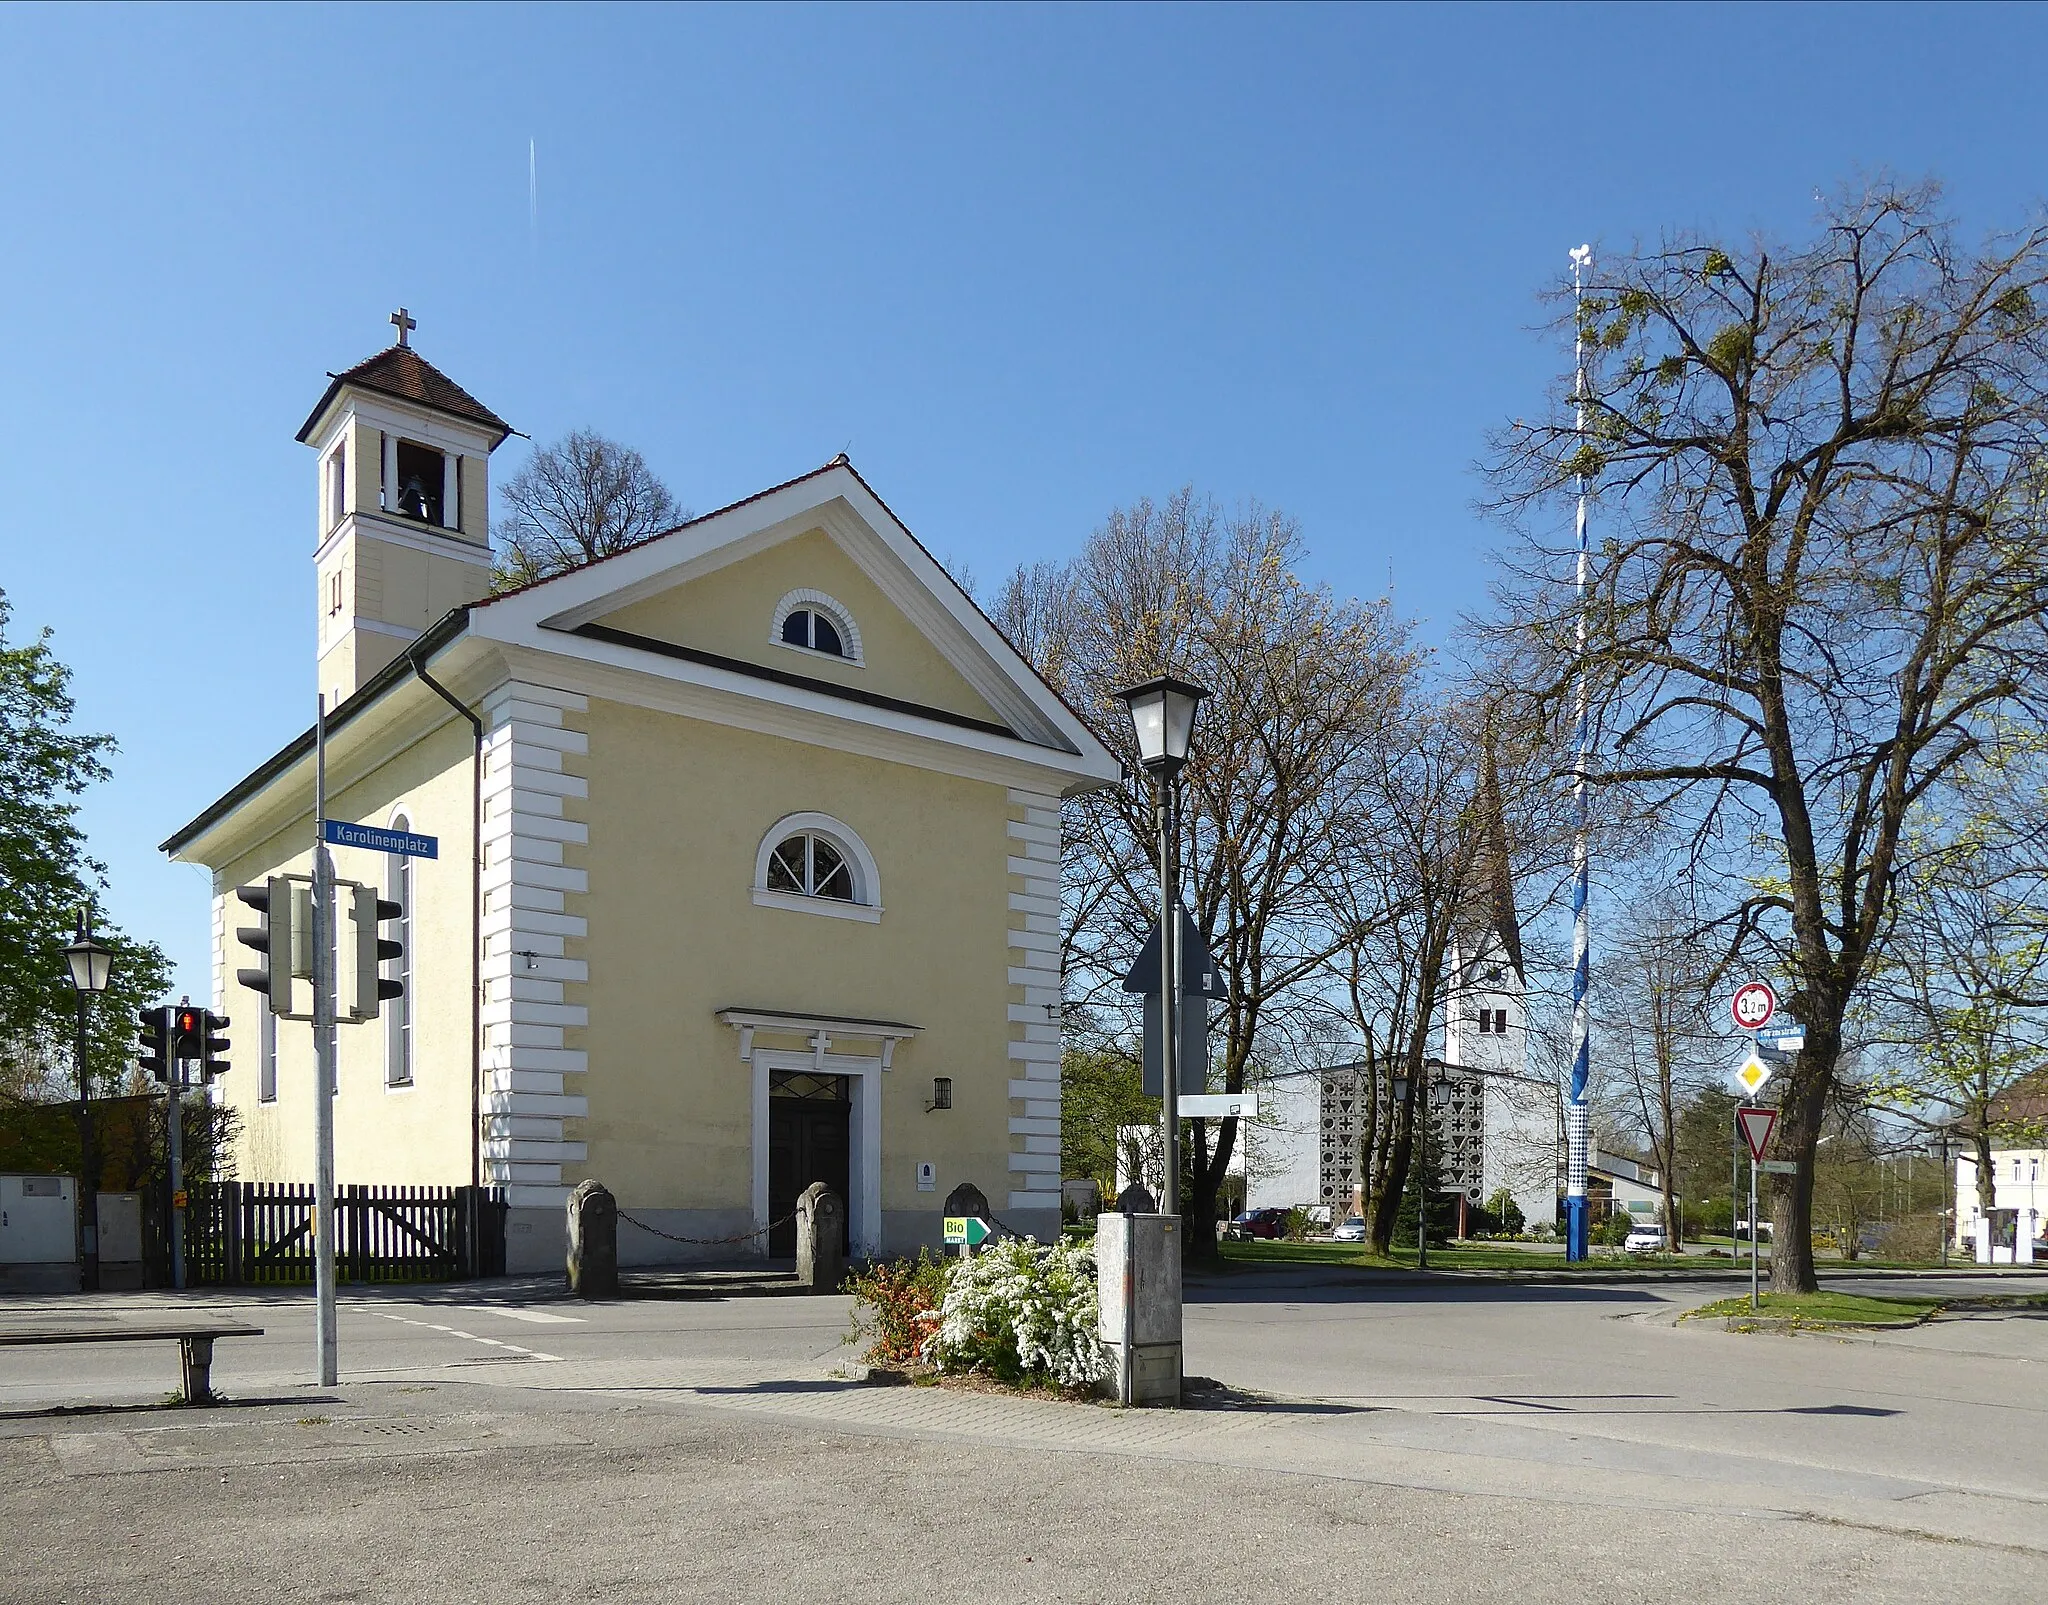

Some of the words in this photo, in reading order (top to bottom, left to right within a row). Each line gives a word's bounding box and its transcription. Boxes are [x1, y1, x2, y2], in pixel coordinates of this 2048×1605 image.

[337, 825, 428, 853] Karolinenplatz
[1758, 1004, 1767, 1012] m
[946, 1221, 964, 1233] Bio
